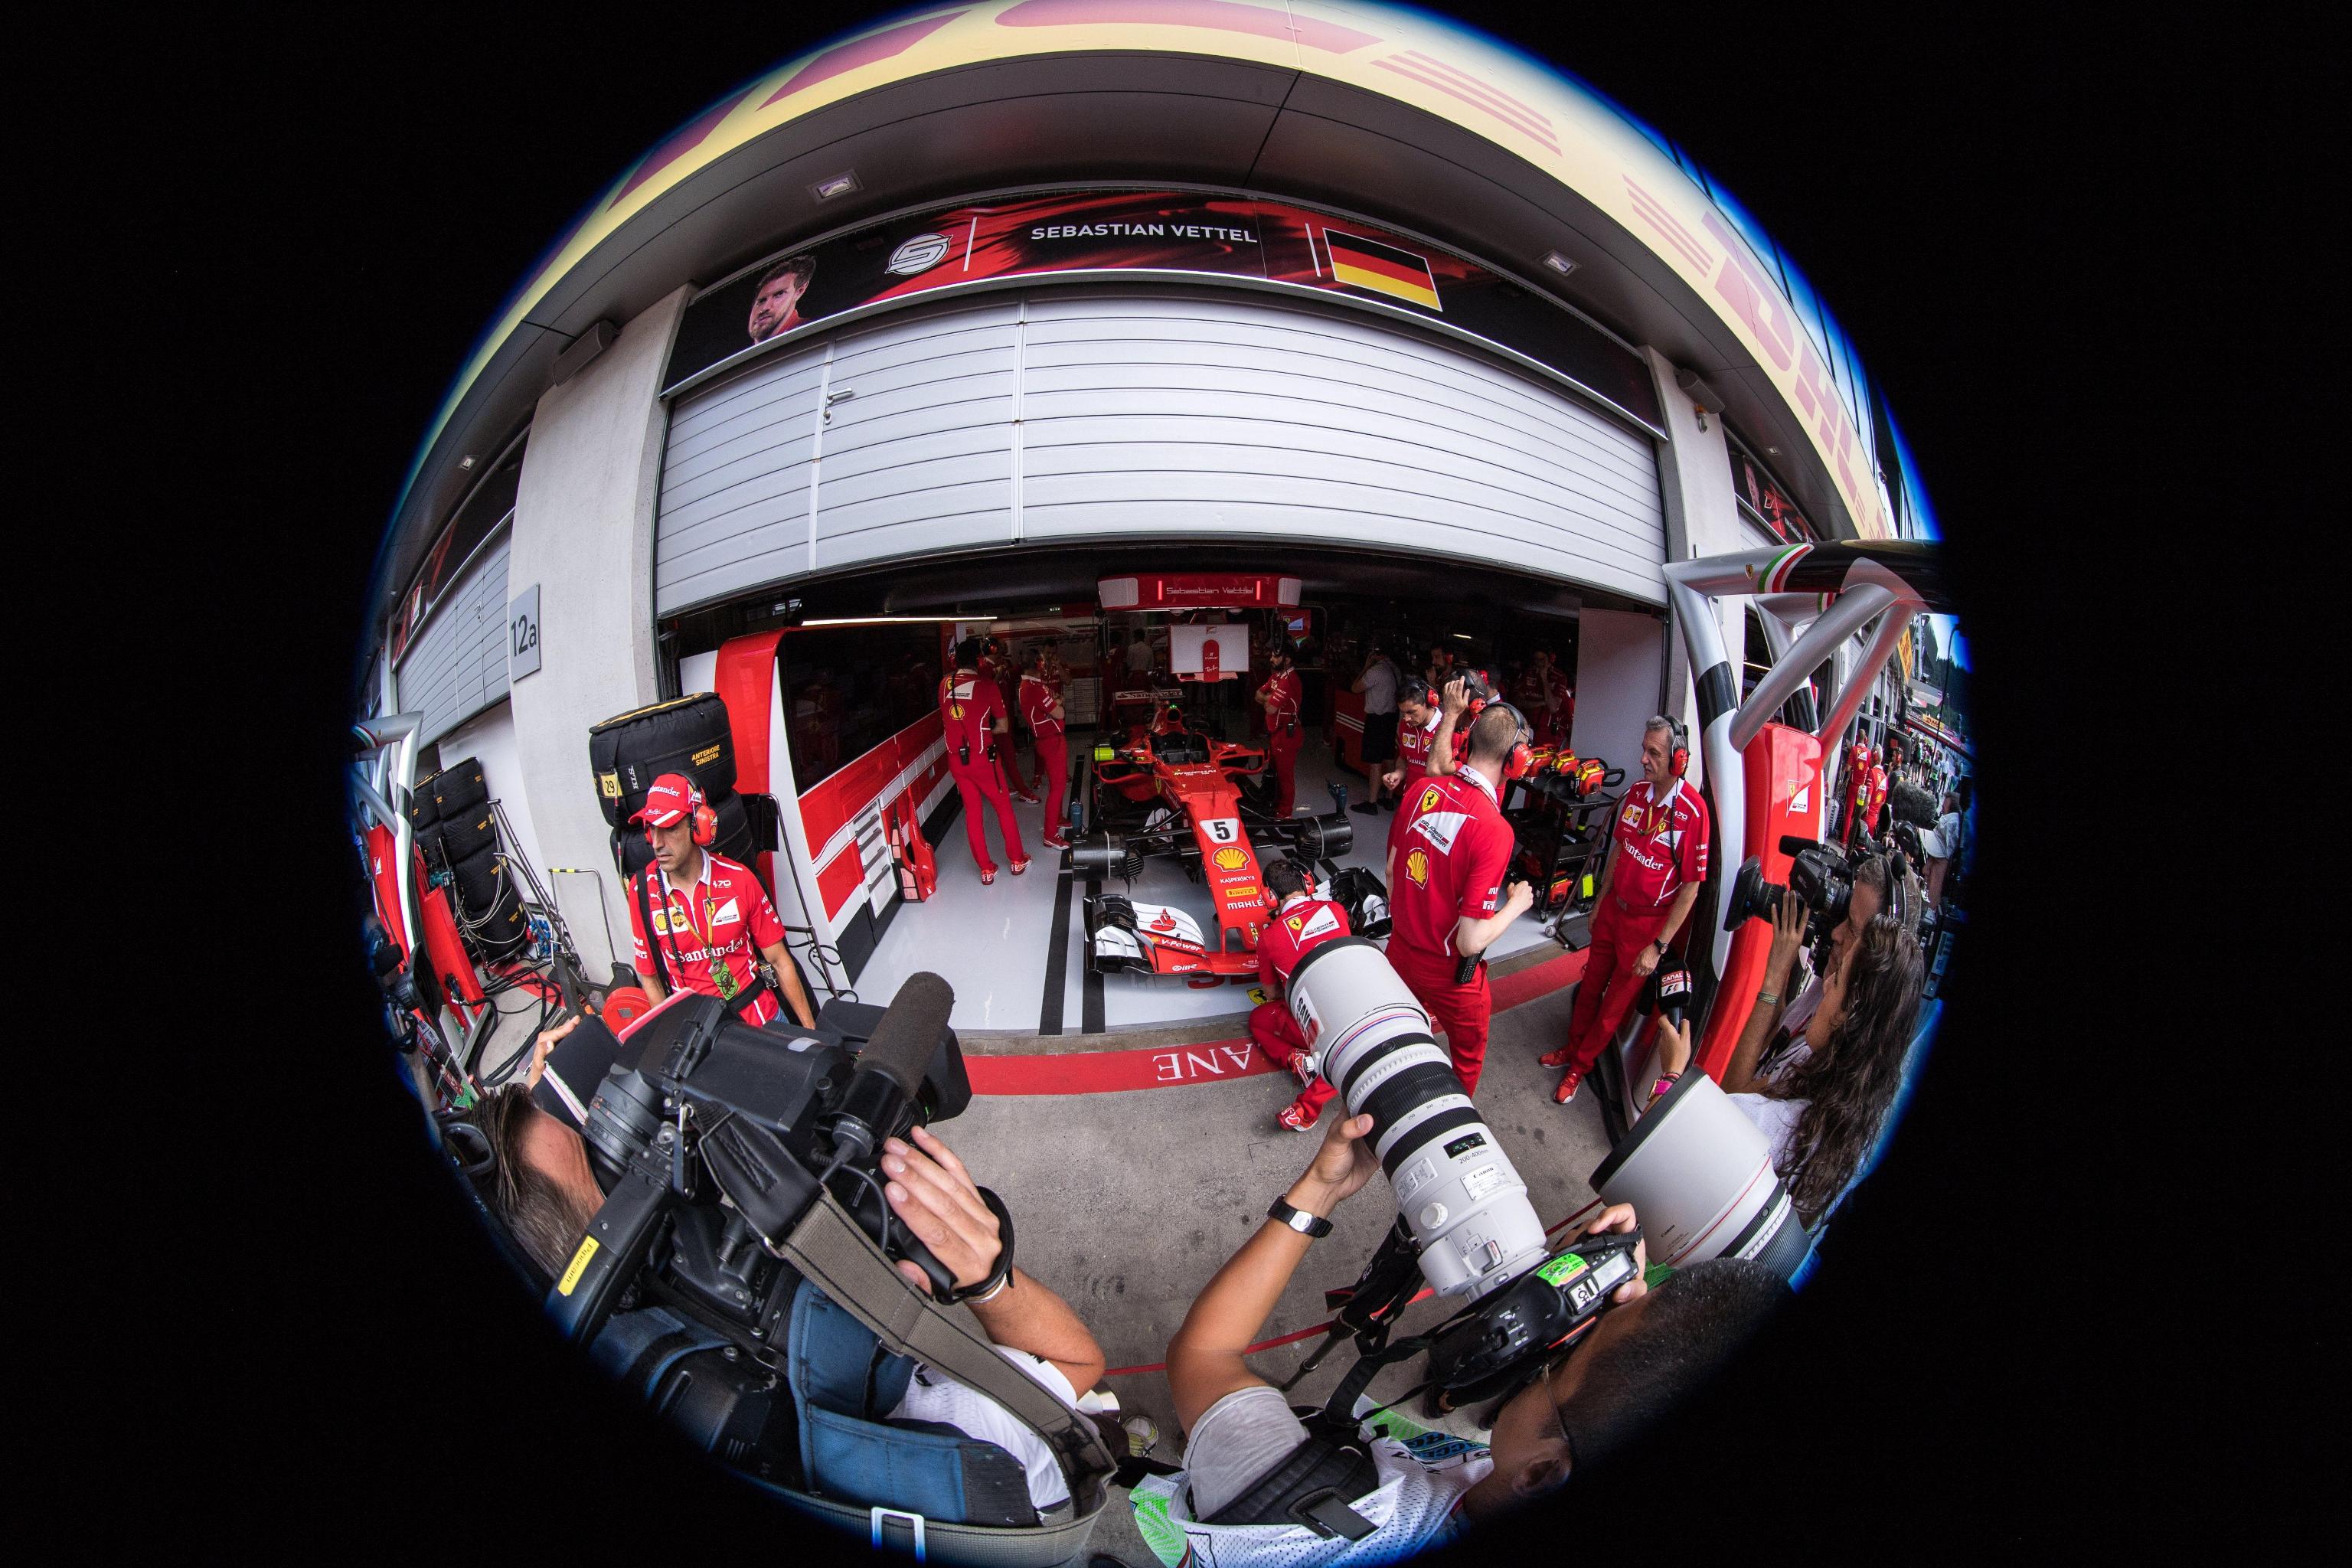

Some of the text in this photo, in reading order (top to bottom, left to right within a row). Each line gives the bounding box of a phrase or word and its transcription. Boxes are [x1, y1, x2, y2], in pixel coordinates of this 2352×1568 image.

[1031, 224, 1257, 243] SEBASTIAN VETTEL
[1166, 586, 1253, 595] Sebastian Vettel
[511, 614, 537, 658] 12a
[692, 744, 720, 761] ANTERIORE
[695, 752, 720, 766] SINISTRA
[605, 780, 615, 793] 29
[1213, 822, 1230, 840] 5
[1625, 838, 1664, 871] Santander
[1227, 899, 1263, 910] MAHLE
[675, 936, 743, 963] Santnder
[1161, 939, 1201, 952] V-Power
[1152, 1042, 1255, 1081] ANE
